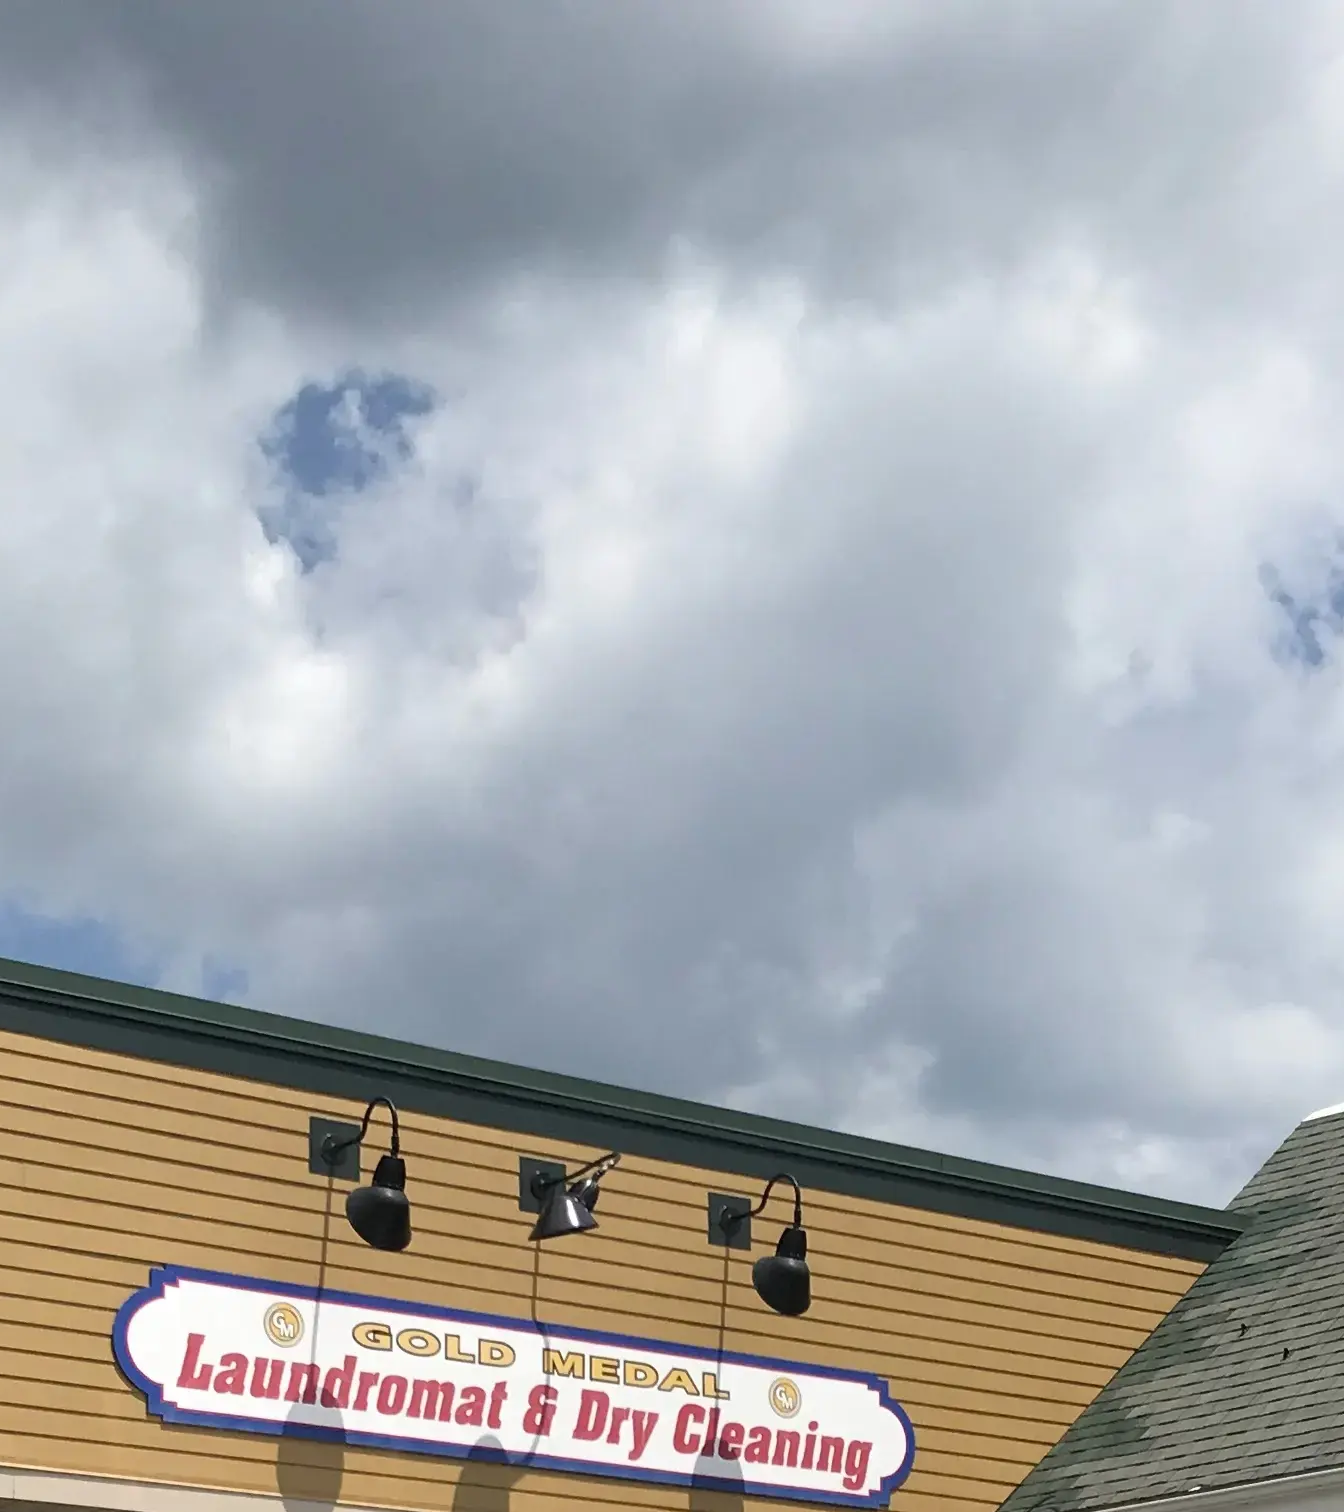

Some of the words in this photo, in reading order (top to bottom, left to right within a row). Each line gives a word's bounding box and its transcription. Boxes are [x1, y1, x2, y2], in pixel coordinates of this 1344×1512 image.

[176, 1332, 508, 1429] Laundromat
[522, 1383, 559, 1437] &
[572, 1388, 659, 1461] Dry
[672, 1403, 873, 1490] Cleaning
[352, 1321, 516, 1368] GOLD
[542, 1348, 730, 1400] MEDAL
